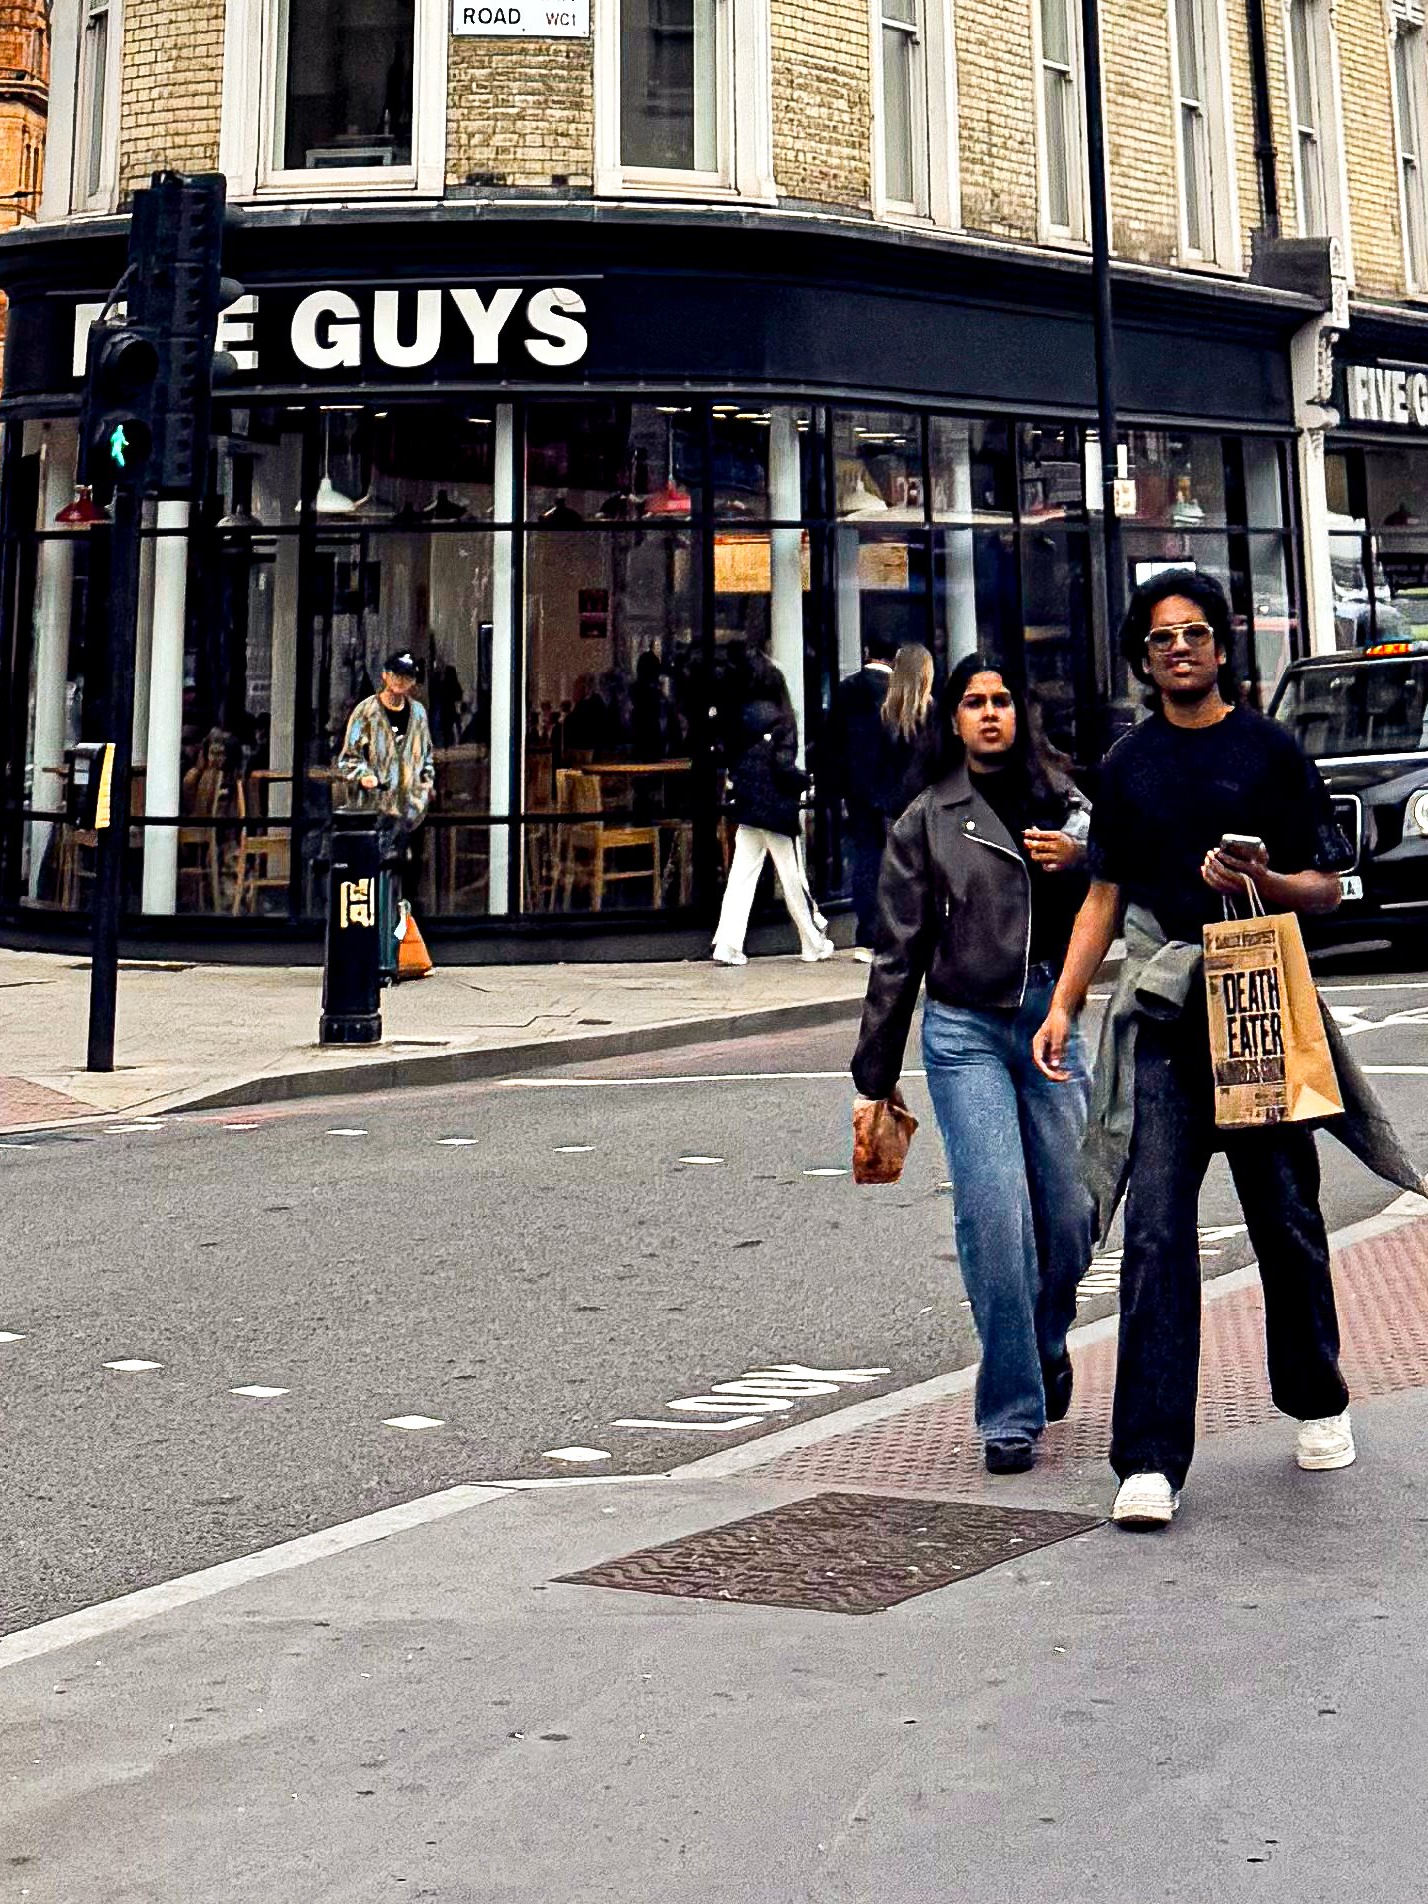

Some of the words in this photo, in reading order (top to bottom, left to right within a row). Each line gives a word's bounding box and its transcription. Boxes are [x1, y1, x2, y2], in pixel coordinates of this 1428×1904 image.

[463, 7, 521, 25] ROAD
[545, 12, 576, 27] WC1
[290, 287, 589, 371] GUYS
[1346, 365, 1409, 424] FIVE
[1222, 966, 1281, 1015] DEATH
[1227, 1012, 1285, 1059] EATER
[609, 1362, 891, 1432] LOOK
